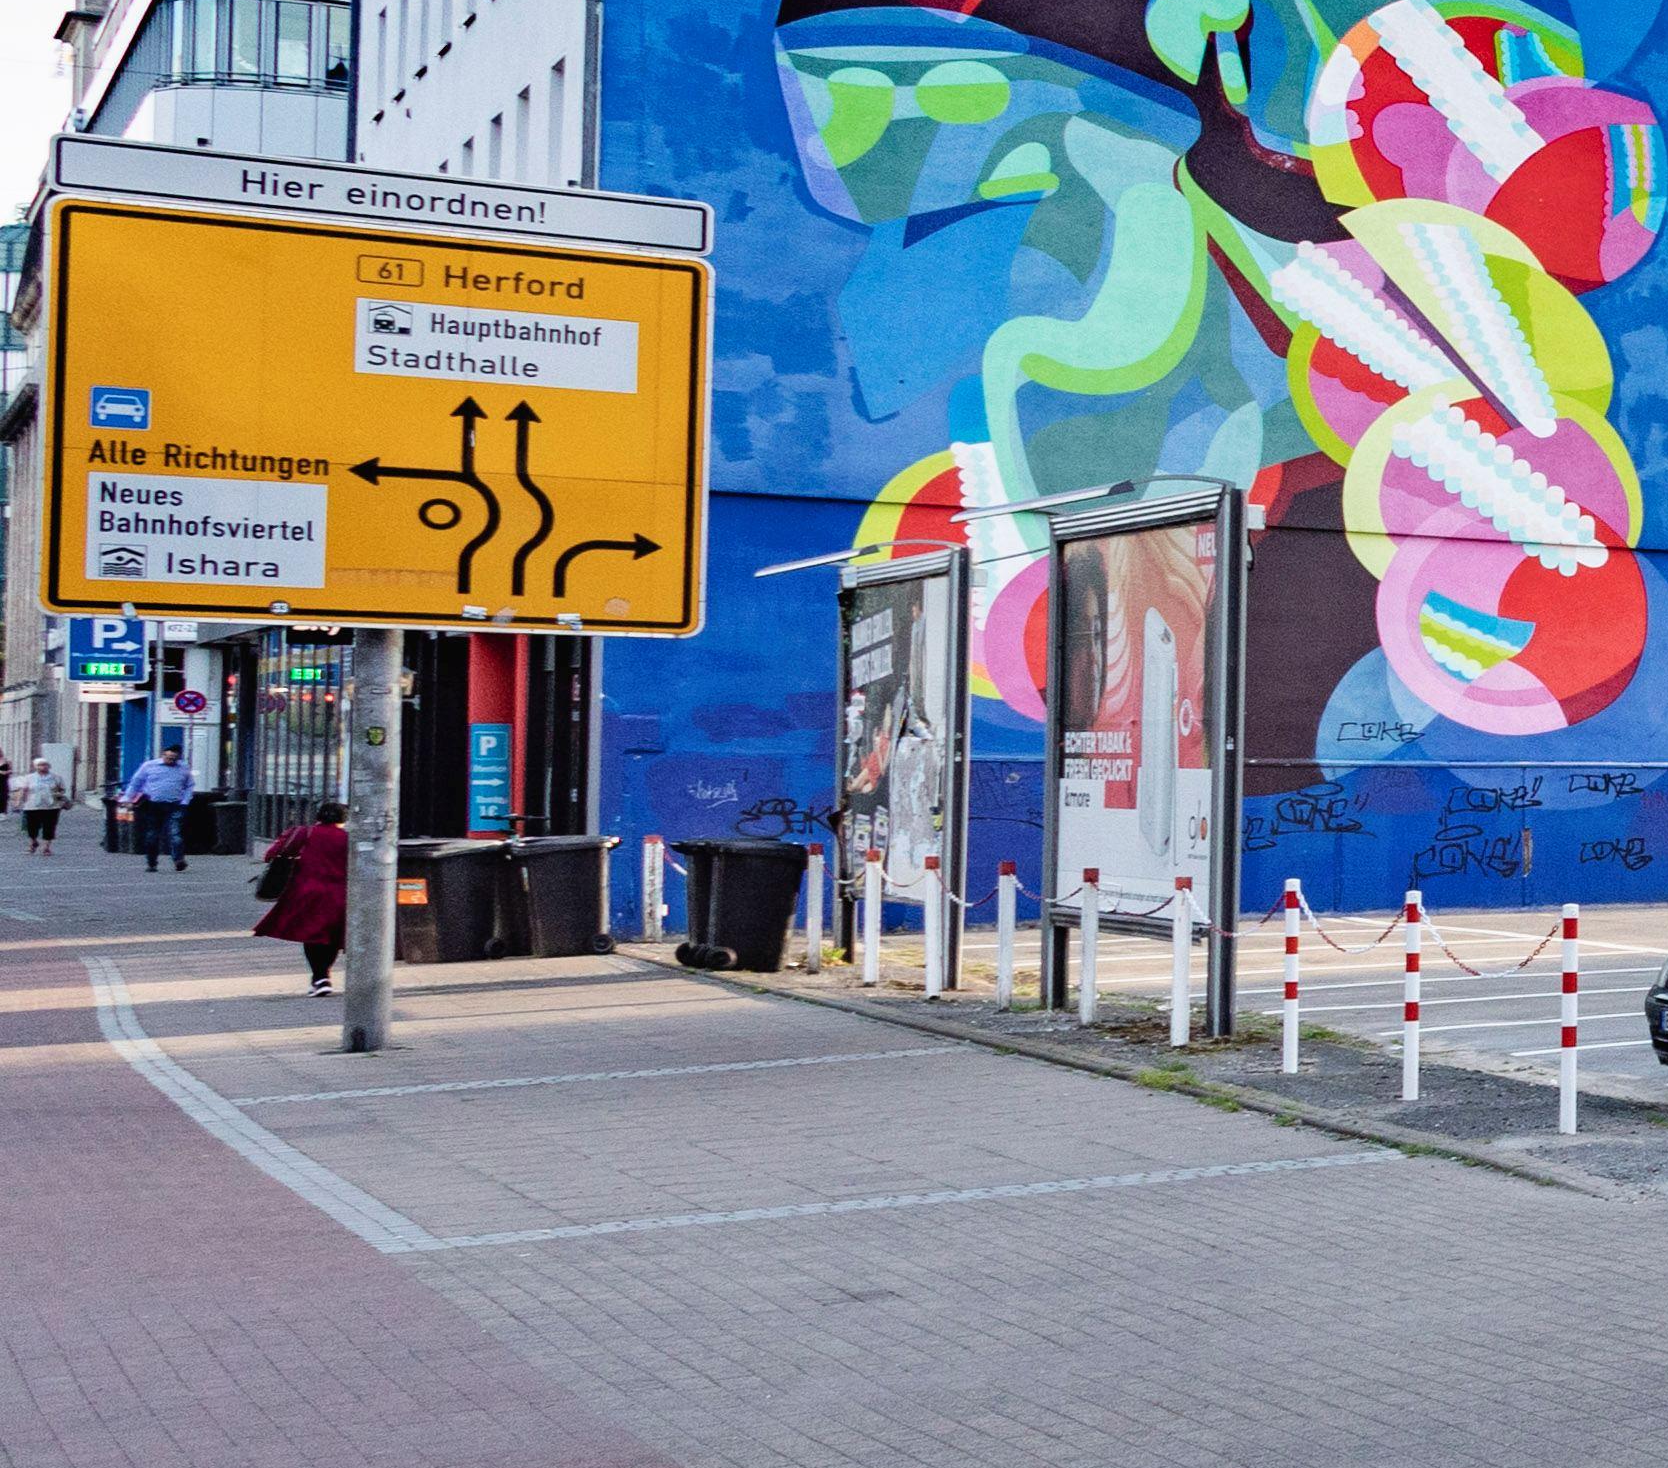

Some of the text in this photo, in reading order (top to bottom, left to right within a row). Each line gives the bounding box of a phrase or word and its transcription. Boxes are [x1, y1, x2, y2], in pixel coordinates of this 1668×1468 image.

[241, 169, 547, 224] Hier einordnen!
[378, 261, 586, 299] 61 Herford
[430, 312, 603, 347] Hauptbahnhof
[367, 344, 540, 378] Stadthalle
[88, 439, 330, 480] Alle Richtungen
[100, 481, 184, 506] Neues
[100, 510, 315, 542] Bahnhofsviertel
[167, 552, 280, 578] Ishara
[92, 618, 128, 648] P
[479, 735, 498, 756] P
